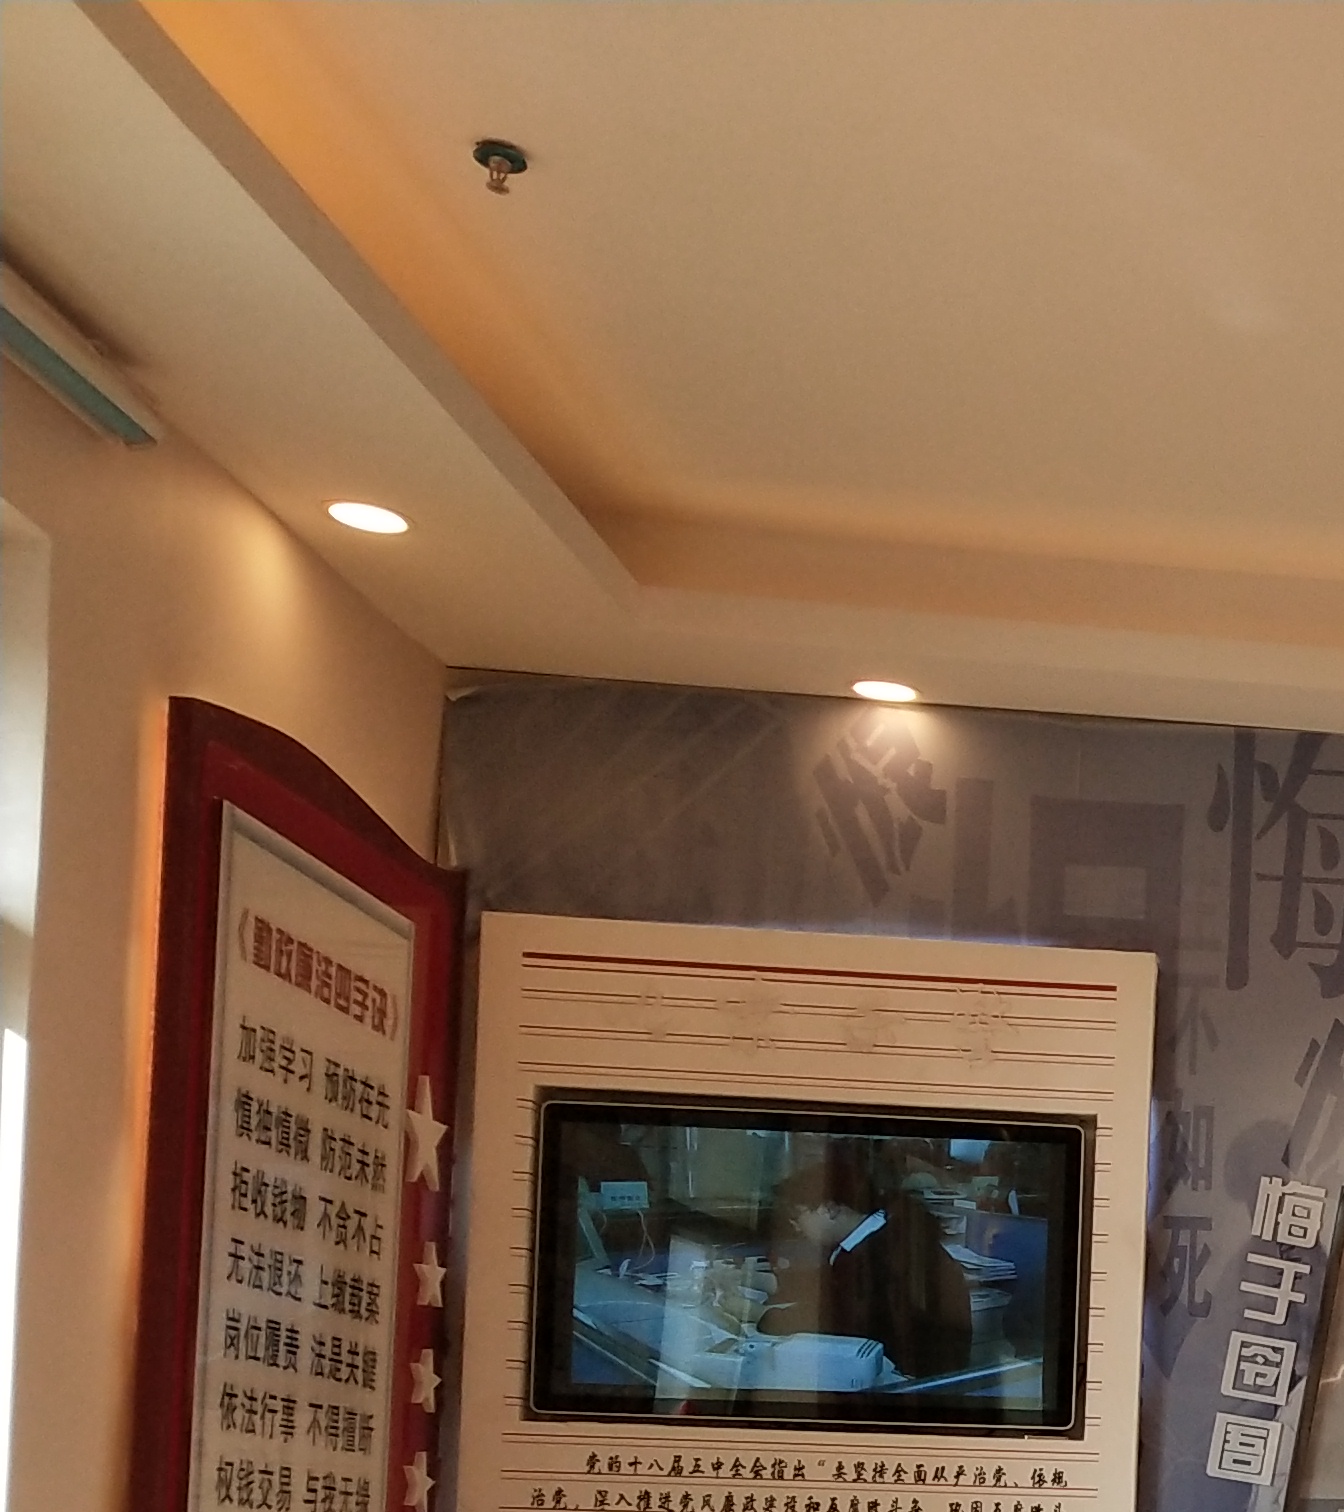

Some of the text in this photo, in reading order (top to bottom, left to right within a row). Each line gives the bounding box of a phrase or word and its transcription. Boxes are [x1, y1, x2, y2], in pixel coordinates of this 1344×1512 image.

[238, 1015, 390, 1129] 加强学习 预防在先
[235, 1087, 387, 1193] 慎独慎微 防范未然
[231, 1160, 383, 1261] 拒收钱物 不贪不占
[227, 1237, 303, 1302] 无法退还
[223, 1308, 378, 1391] 岗位履责 法是关键
[220, 1381, 297, 1443] 依法行事
[215, 1454, 291, 1512] 权钱交易
